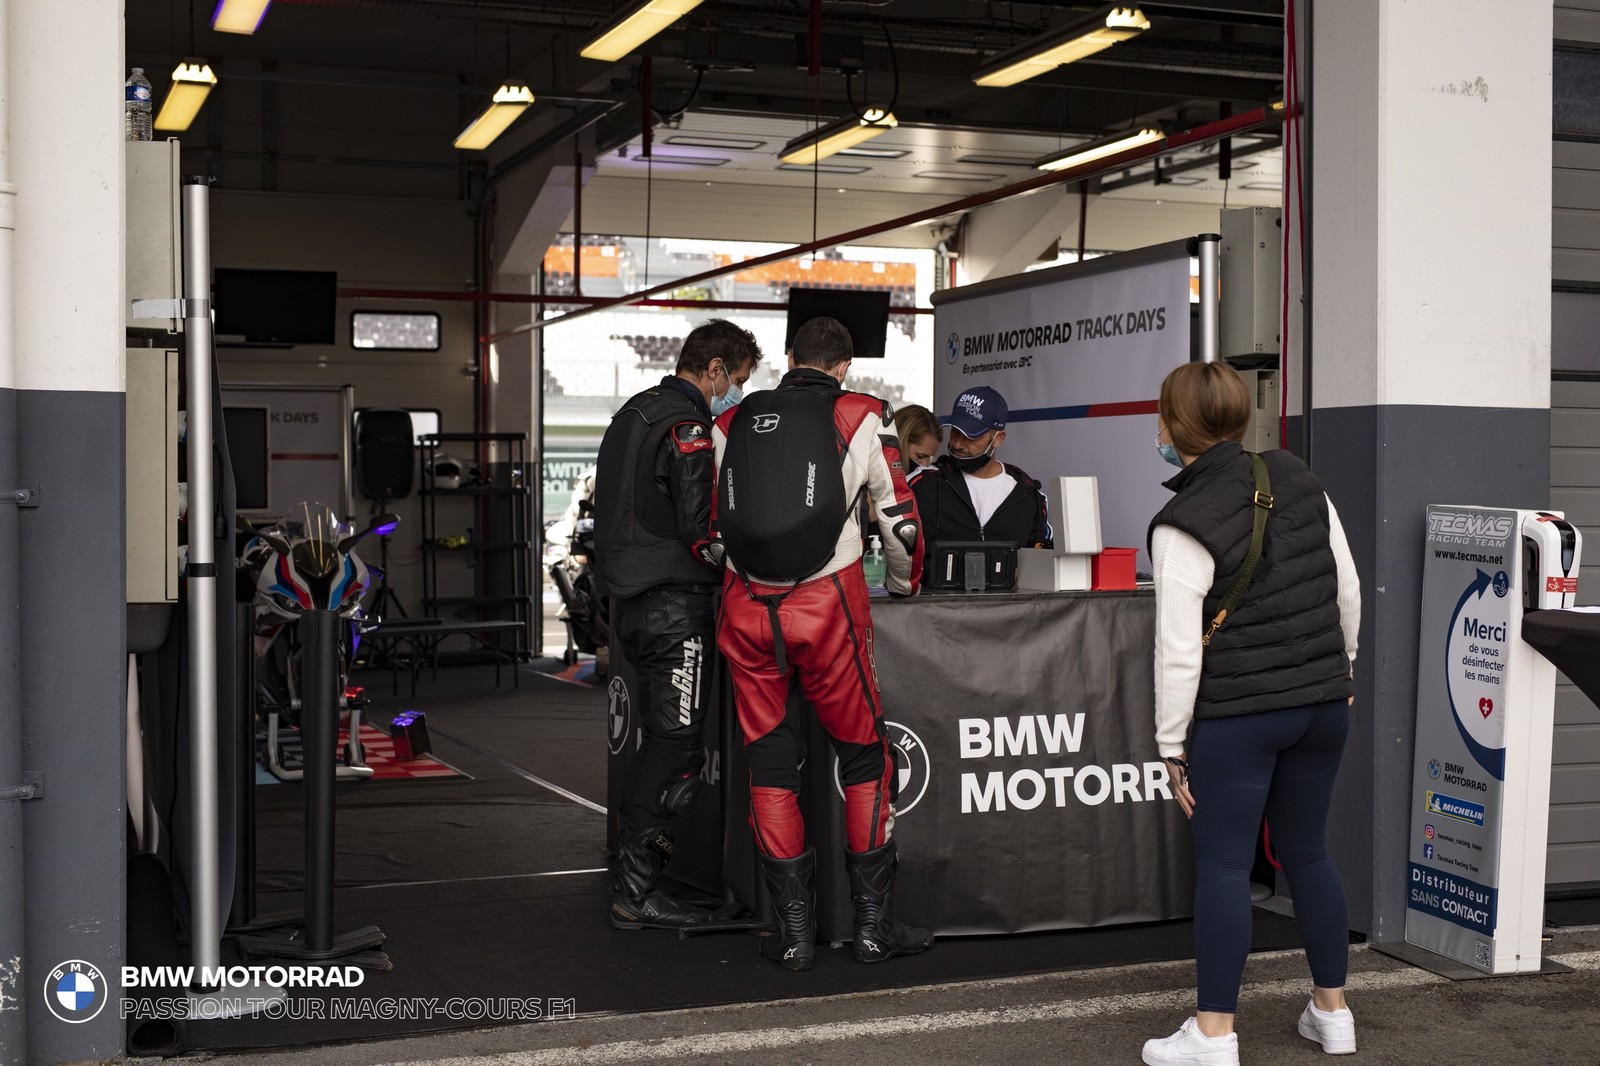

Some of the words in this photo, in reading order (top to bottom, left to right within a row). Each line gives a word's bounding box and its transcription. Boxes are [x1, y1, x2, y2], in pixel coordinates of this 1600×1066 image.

[963, 333, 995, 356] BMW
[997, 322, 1072, 352] MOTORRAD
[1076, 313, 1124, 341] TRACK
[1126, 307, 1166, 334] DAYS
[963, 363, 971, 374] En
[970, 360, 1002, 376] partenariat
[1003, 360, 1018, 370] avec
[960, 394, 984, 407] BMW
[283, 412, 319, 424] DAYS
[965, 407, 983, 420] TOUR
[727, 467, 736, 511] COURSE
[805, 461, 816, 507] COURSE
[1429, 512, 1514, 540] TECMAS
[1428, 534, 1470, 545] RACING
[1475, 538, 1506, 548] TEAM
[1434, 549, 1504, 565] www.tecmas.net
[1463, 616, 1507, 643] Merci
[1468, 643, 1479, 653] de
[1480, 647, 1499, 657] vous
[1462, 655, 1505, 672] désinfecter
[1464, 669, 1476, 681] les
[1477, 673, 1500, 685] mains
[958, 712, 1086, 759] BMW
[1444, 762, 1465, 775] BMW
[961, 761, 1176, 813] MOTORR
[1443, 773, 1487, 792] MOTORRAD
[1442, 803, 1484, 820] MICHELIN
[1412, 868, 1490, 905] Distributeur
[1411, 888, 1440, 908] SANS
[1441, 898, 1489, 926] CONTACT
